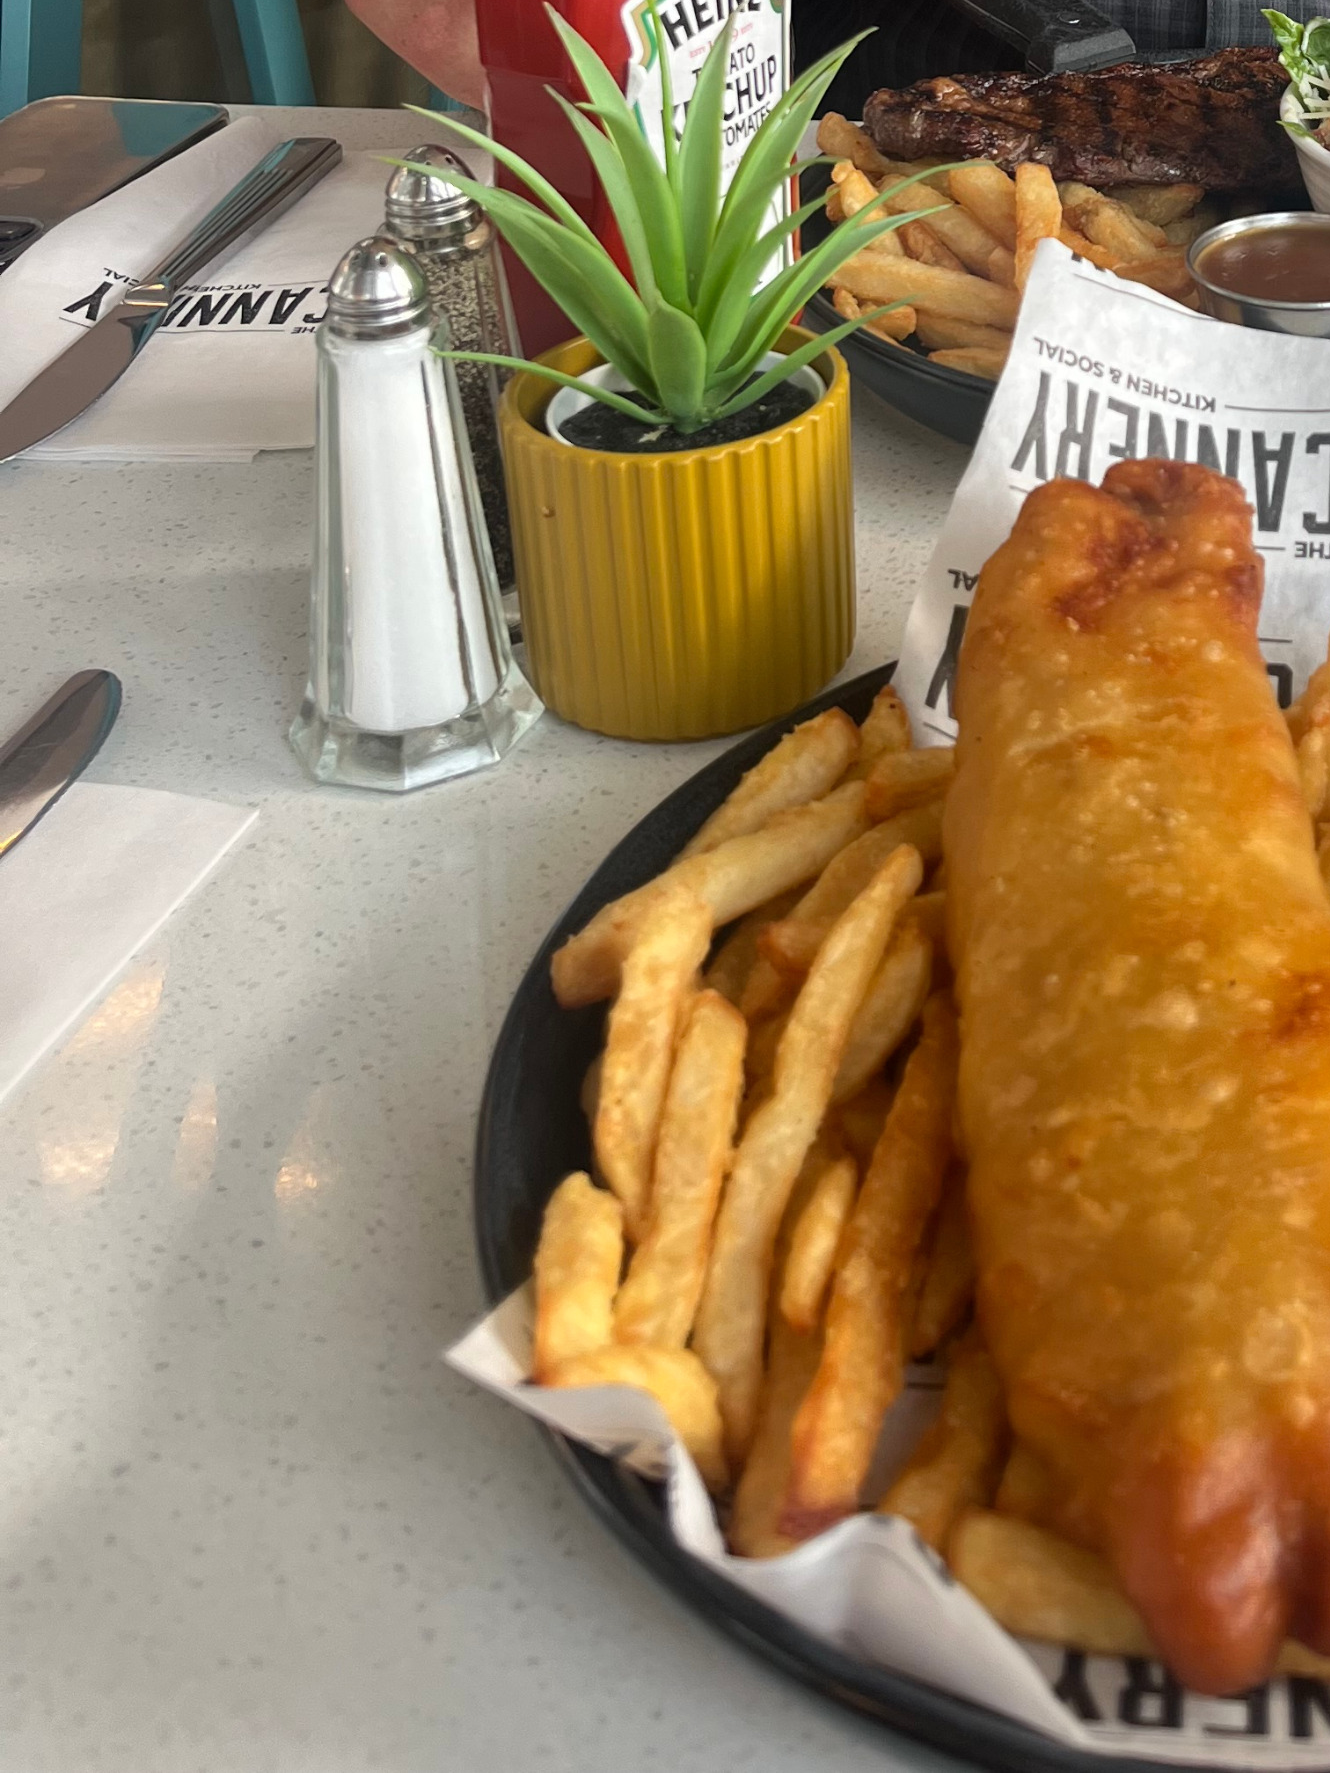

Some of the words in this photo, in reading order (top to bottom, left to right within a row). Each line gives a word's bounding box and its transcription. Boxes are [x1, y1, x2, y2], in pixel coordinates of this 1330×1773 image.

[1033, 336, 1105, 378] SOCIAL
[1109, 366, 1123, 385] &
[1126, 373, 1217, 413] KITCHEN
